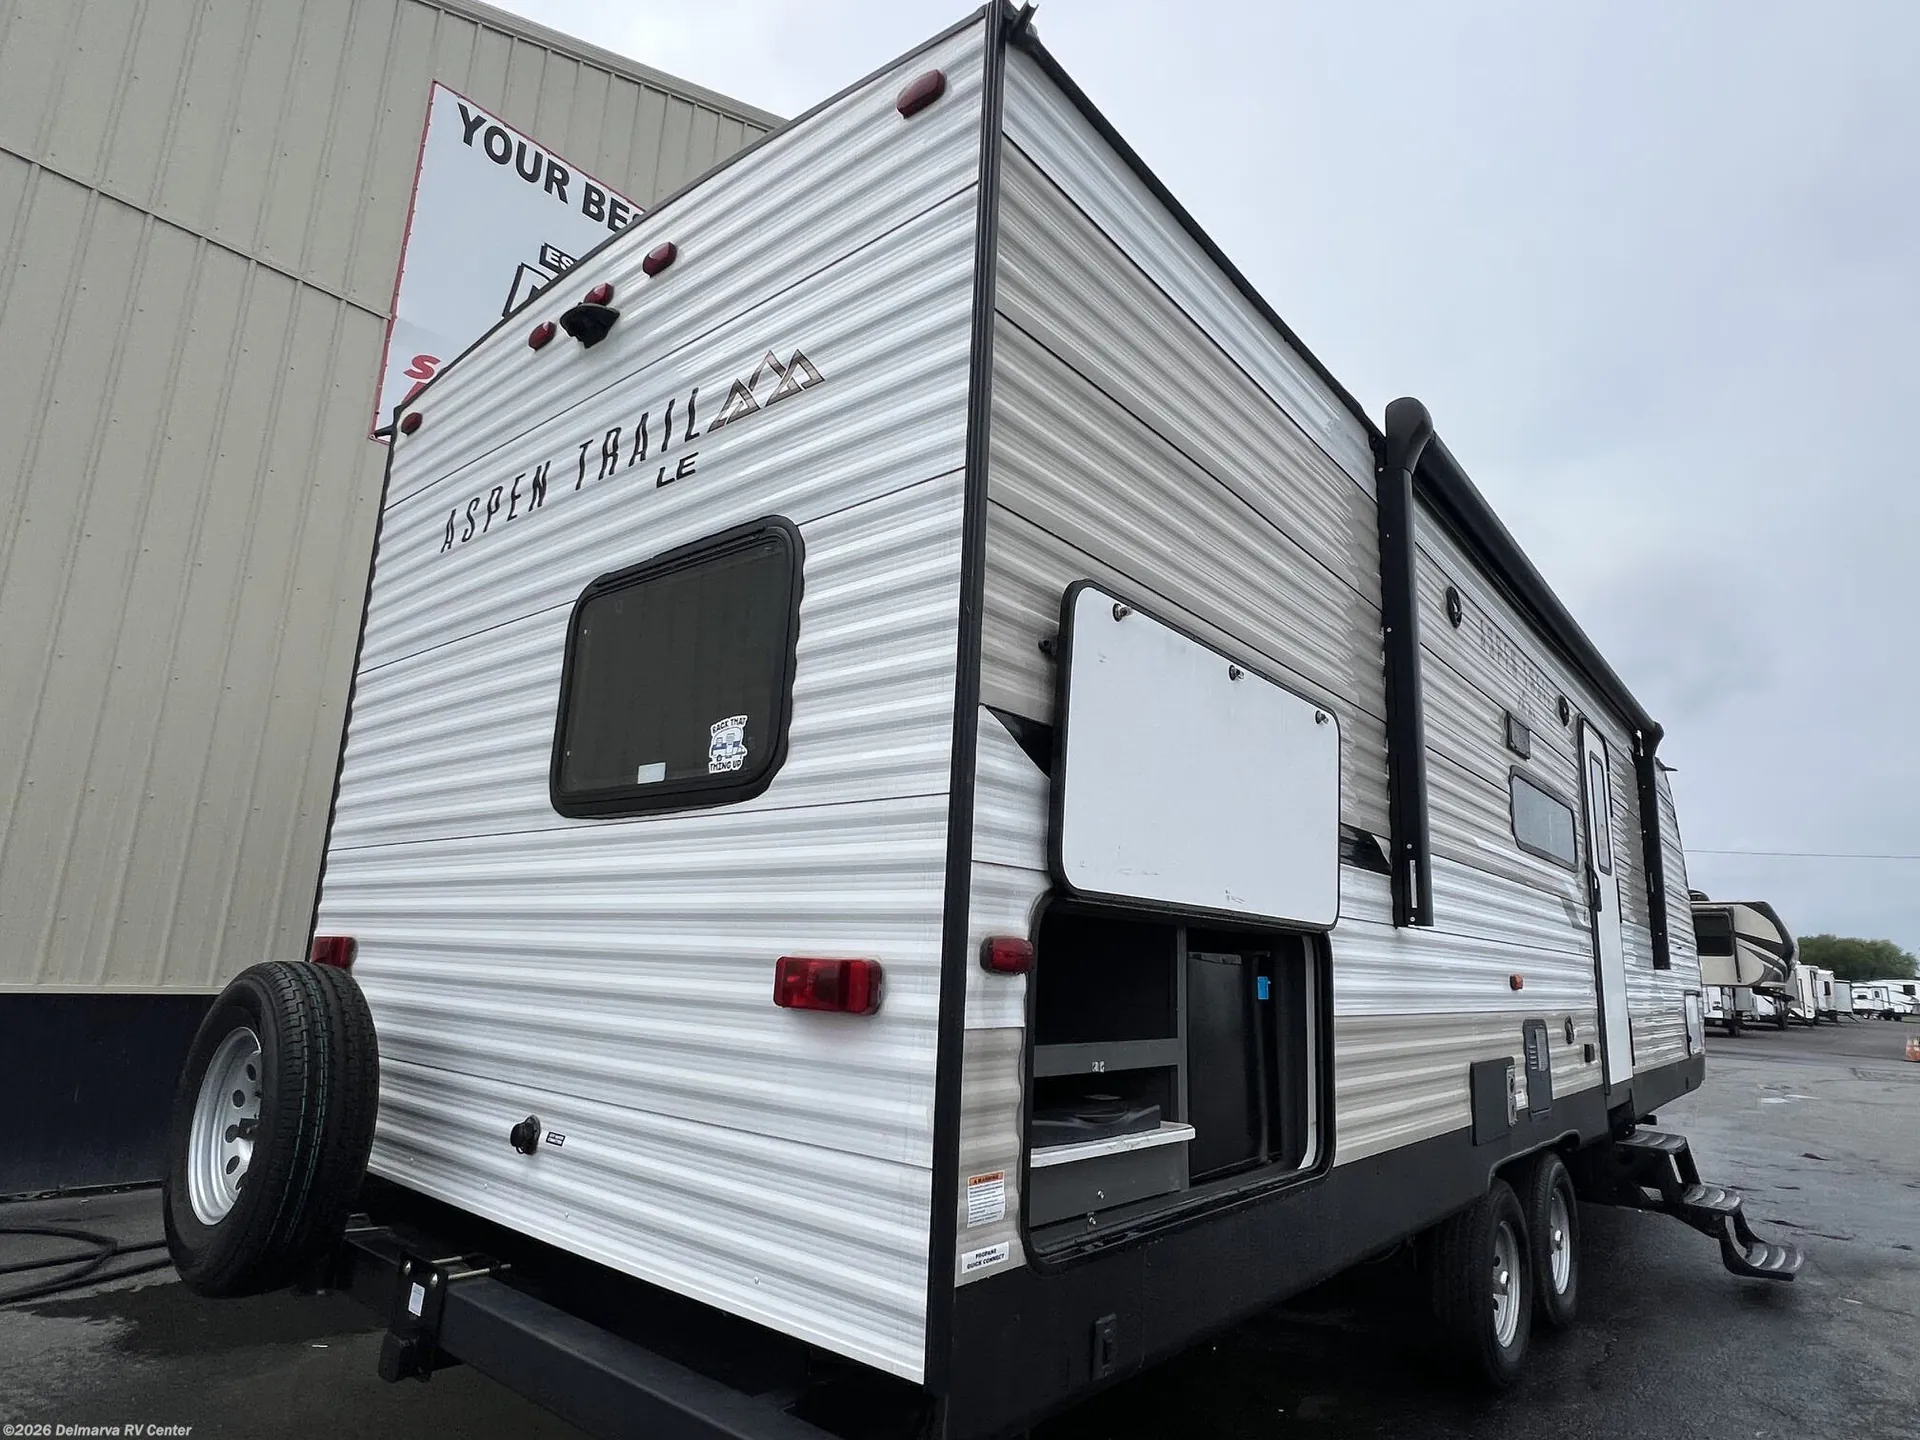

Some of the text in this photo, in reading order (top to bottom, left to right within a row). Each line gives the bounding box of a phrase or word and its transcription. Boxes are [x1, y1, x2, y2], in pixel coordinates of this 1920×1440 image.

[457, 103, 570, 204] YOUR
[440, 387, 700, 553] ASPEN TRAIL
[656, 451, 699, 488] LE
[712, 717, 746, 733] BACK THAT
[710, 760, 742, 772] THING UP
[966, 1253, 1005, 1270] QUICK CONNECT
